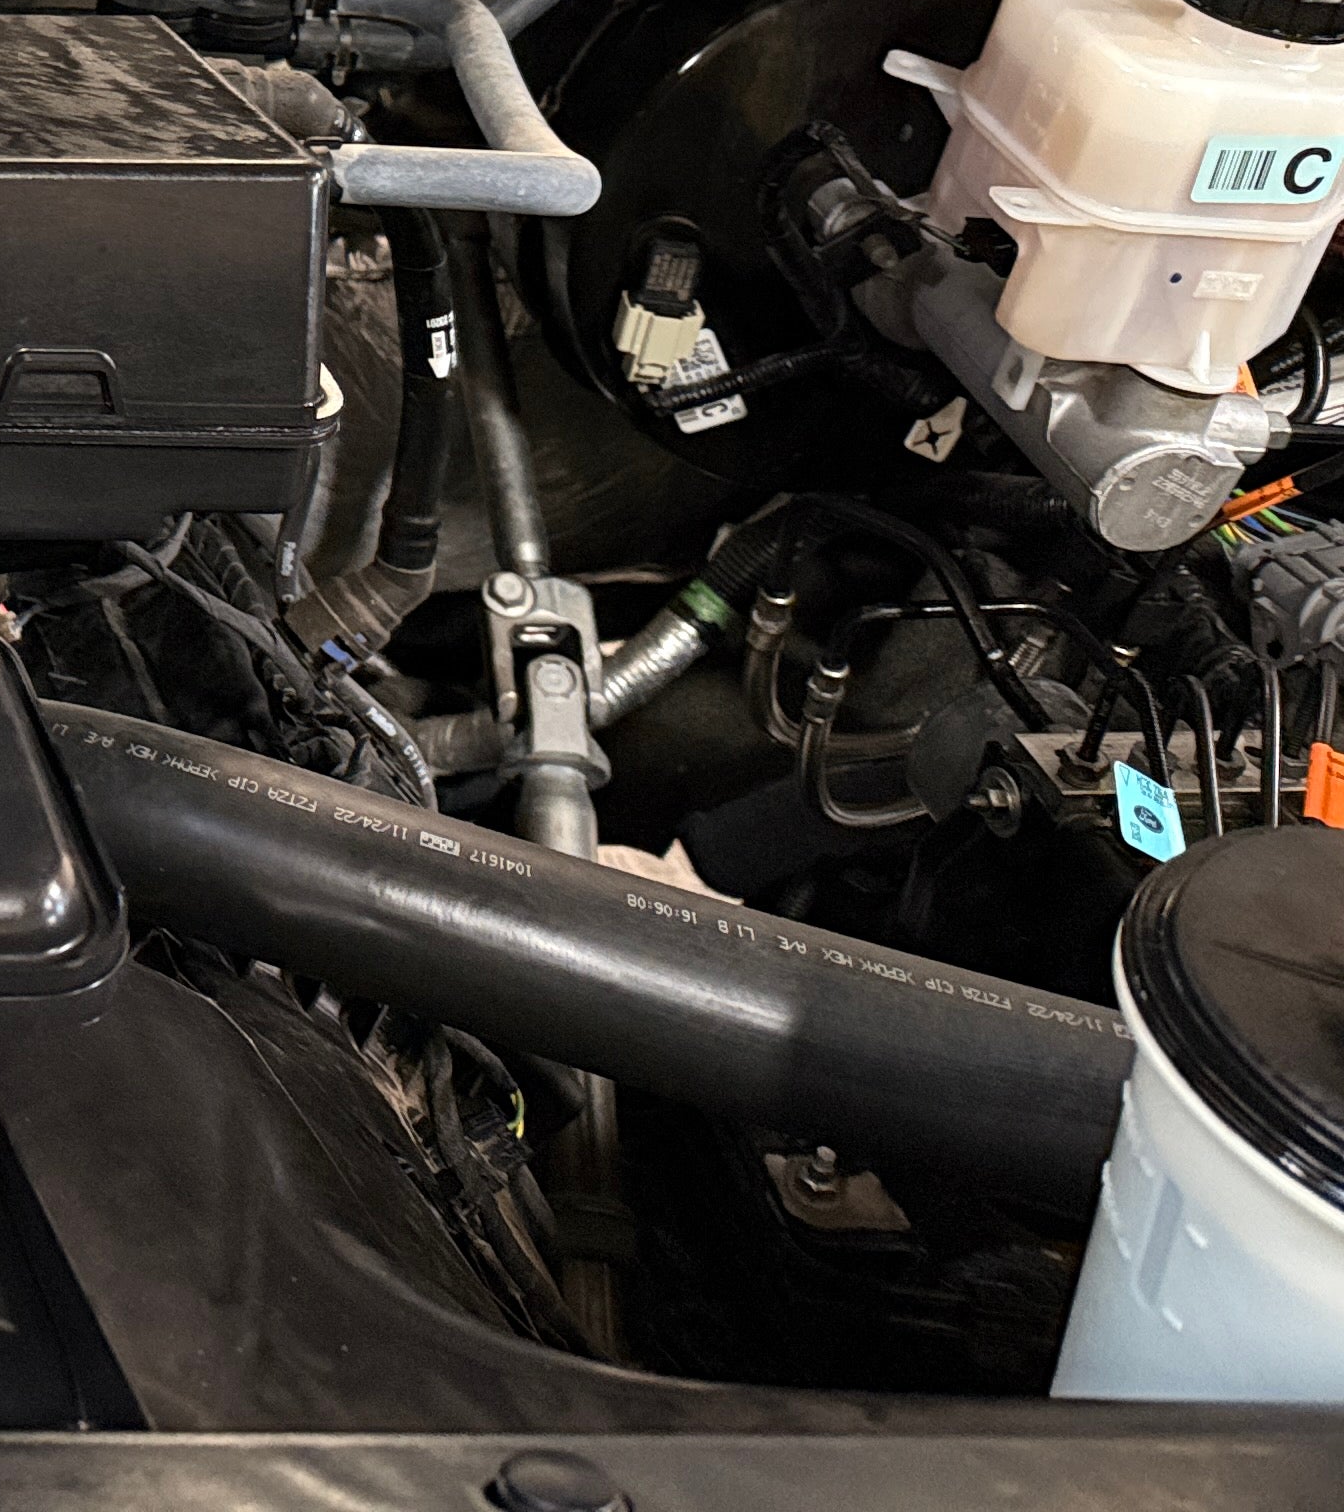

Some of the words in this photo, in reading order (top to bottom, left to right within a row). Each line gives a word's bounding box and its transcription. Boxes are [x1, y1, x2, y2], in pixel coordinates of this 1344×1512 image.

[1284, 147, 1332, 195] C
[701, 402, 729, 418] C
[334, 806, 408, 840] 11/24/22
[469, 849, 532, 877] 1041617
[627, 893, 698, 925] 16:06:08
